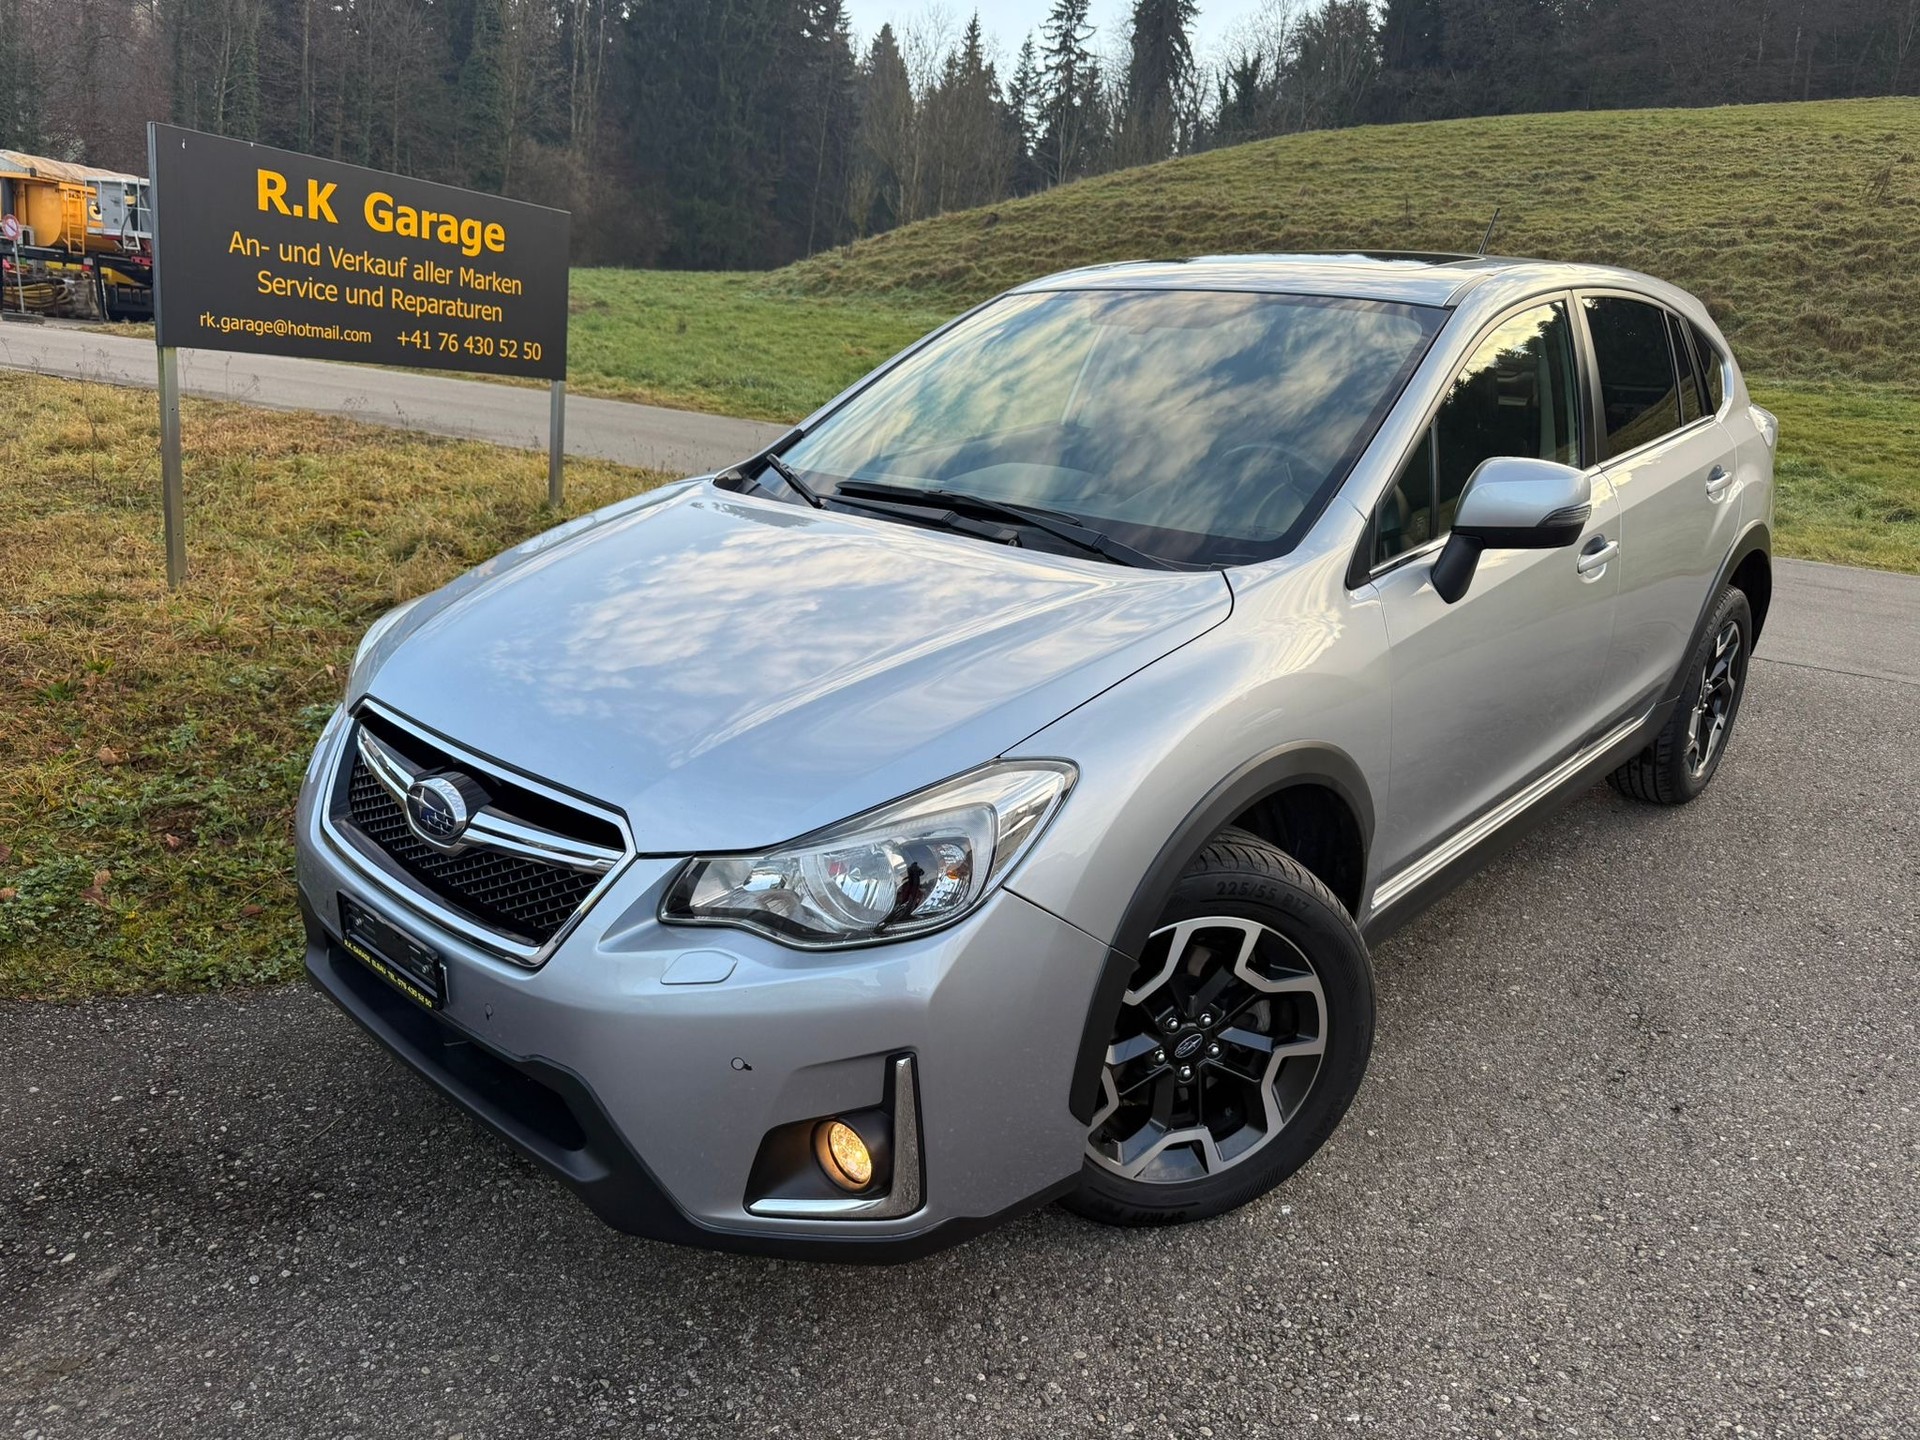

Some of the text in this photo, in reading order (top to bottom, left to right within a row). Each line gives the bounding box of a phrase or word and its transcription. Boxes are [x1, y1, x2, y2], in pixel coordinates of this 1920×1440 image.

[257, 168, 506, 259] R.K Garage
[228, 230, 523, 296] An- und Verkauf aller Marken
[257, 270, 503, 321] Service und Reparaturen
[199, 312, 543, 362] rk.garage@hotmail.com +41 76 430 52 50
[1216, 880, 1278, 902] 225/55
